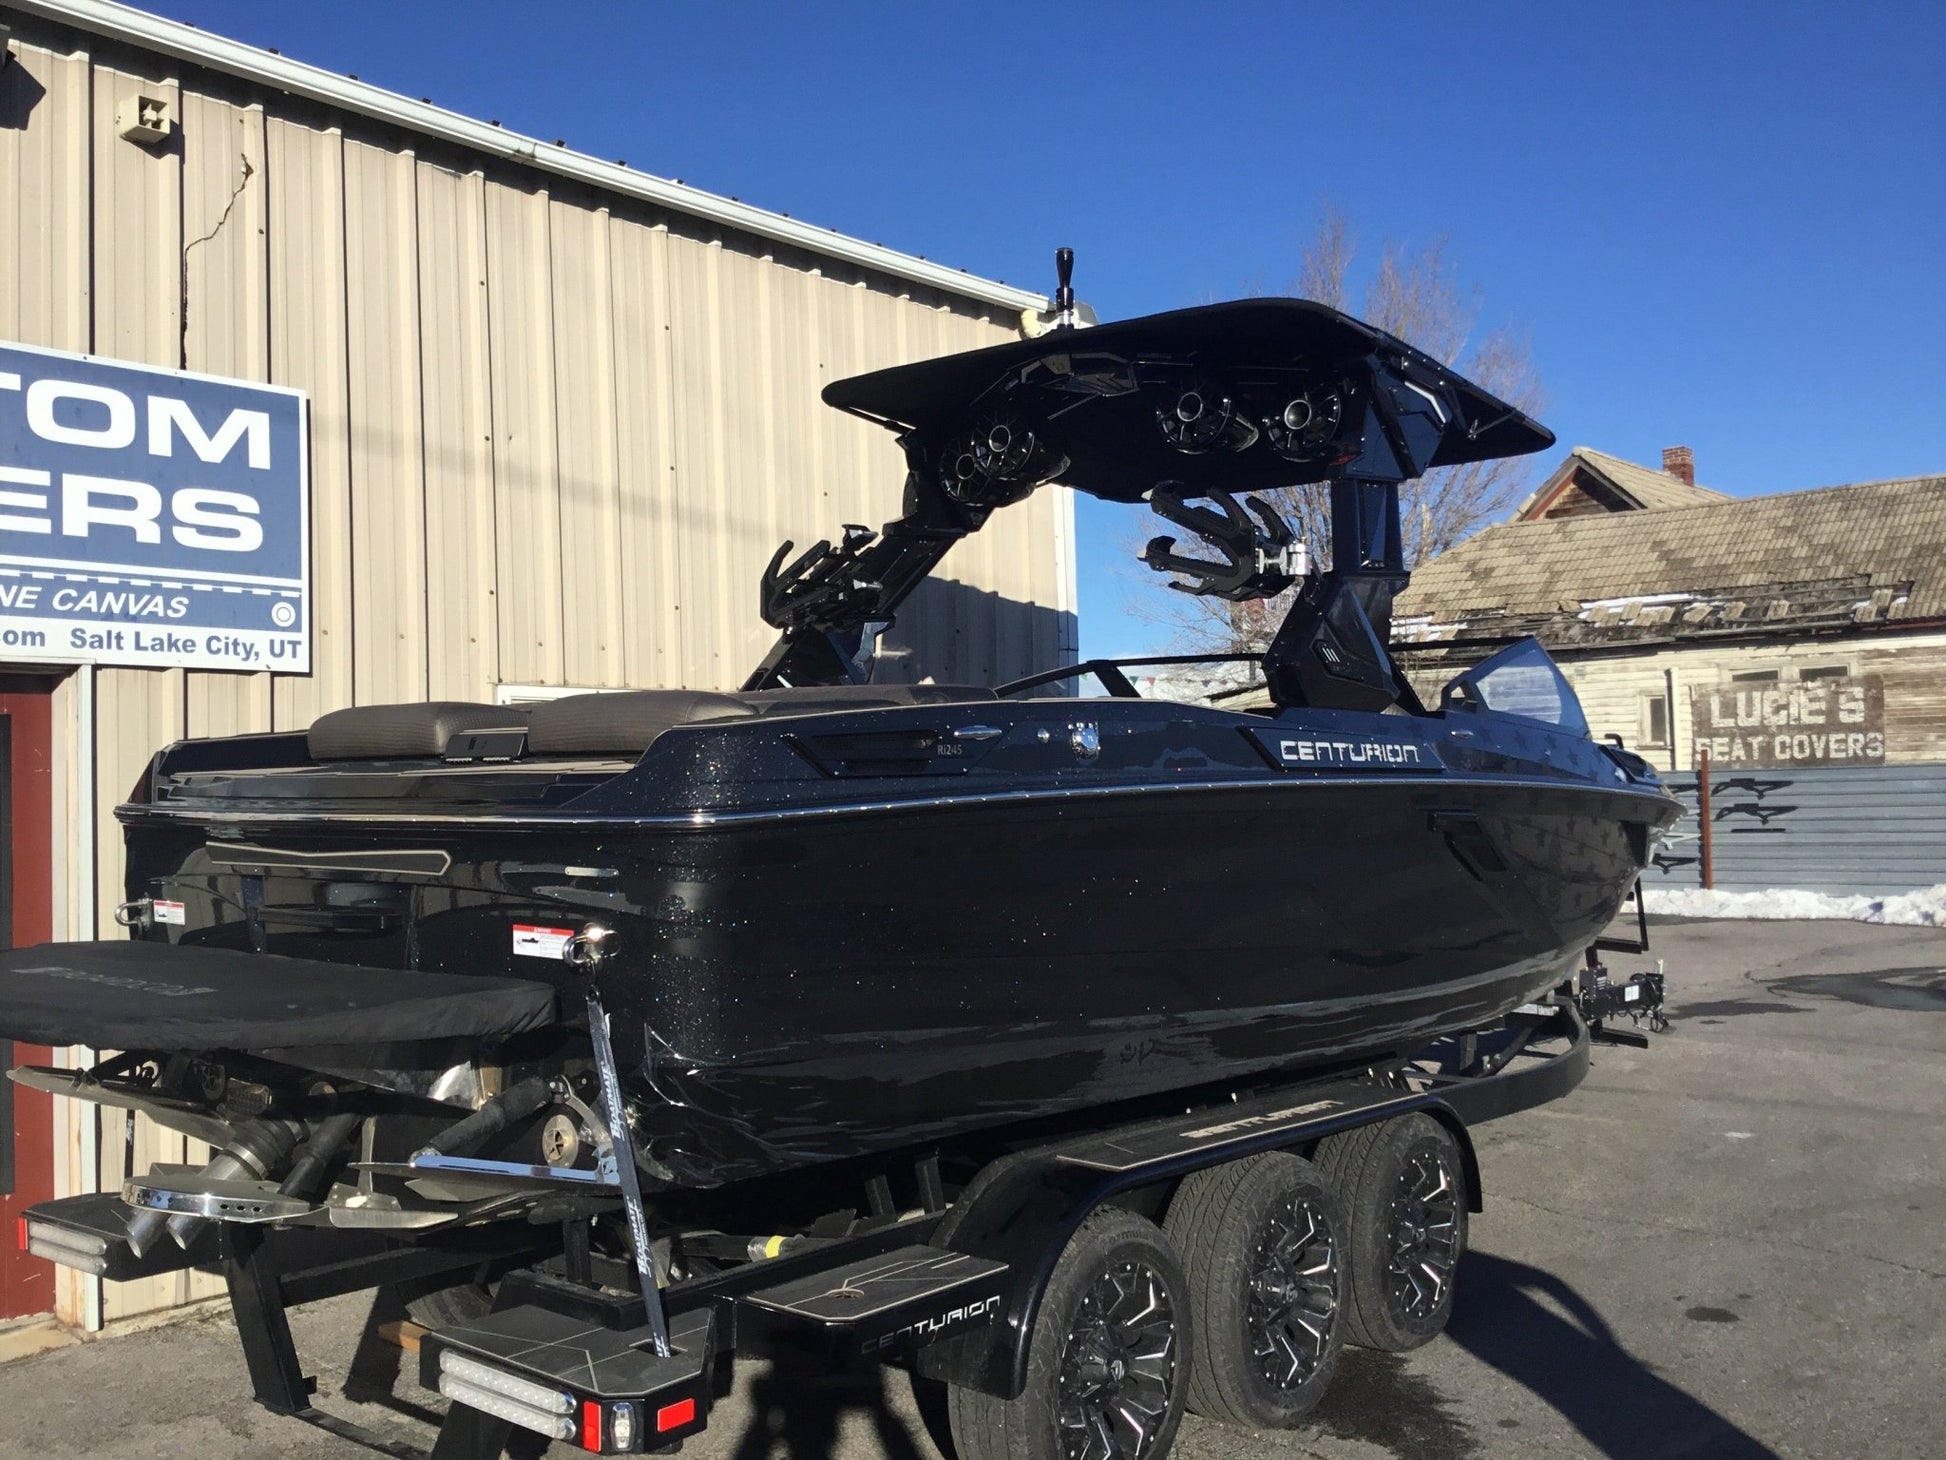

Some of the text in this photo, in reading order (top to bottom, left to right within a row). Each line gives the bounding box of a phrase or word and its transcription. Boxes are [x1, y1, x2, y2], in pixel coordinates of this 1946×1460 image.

[0, 372, 271, 470] OM
[52, 588, 190, 618] CANVAS
[69, 627, 124, 650] Salt
[134, 631, 196, 653] Lake
[206, 635, 260, 661] City,
[269, 639, 302, 658] UT
[1280, 740, 1421, 762] CENTURION
[1695, 732, 1884, 761] SEAT COVERS
[861, 1295, 1001, 1354] CENTURION
